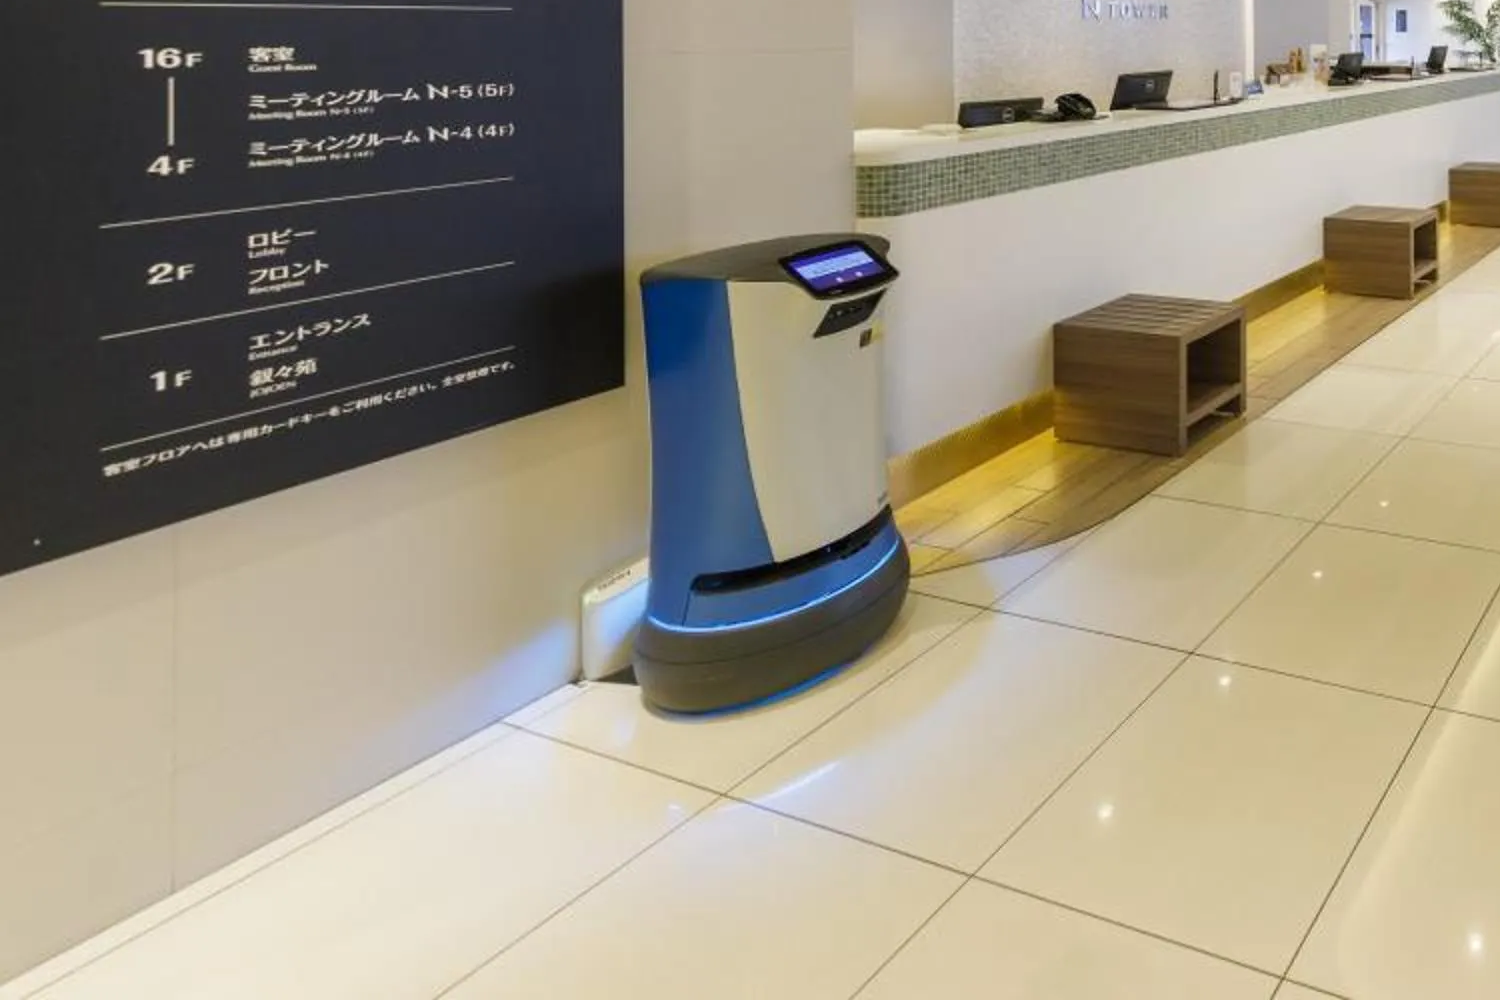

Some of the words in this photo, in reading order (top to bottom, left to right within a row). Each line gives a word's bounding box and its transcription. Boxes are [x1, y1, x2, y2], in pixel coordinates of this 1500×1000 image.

[1109, 0, 1168, 20] TOWER
[137, 48, 202, 70] 16F
[248, 46, 295, 62] 客室
[248, 87, 420, 109] ミーティングルーム
[427, 83, 473, 100] N-5
[477, 83, 515, 98] (5F)
[248, 130, 420, 156] ミーティングルーム
[427, 126, 473, 142] N-4
[477, 123, 515, 139] (4F)
[147, 155, 194, 177] 4F
[248, 229, 317, 249] ロビー
[147, 263, 194, 285] 2F
[248, 259, 329, 285] フロント
[249, 313, 372, 350] エントランス
[150, 368, 192, 391] 1F
